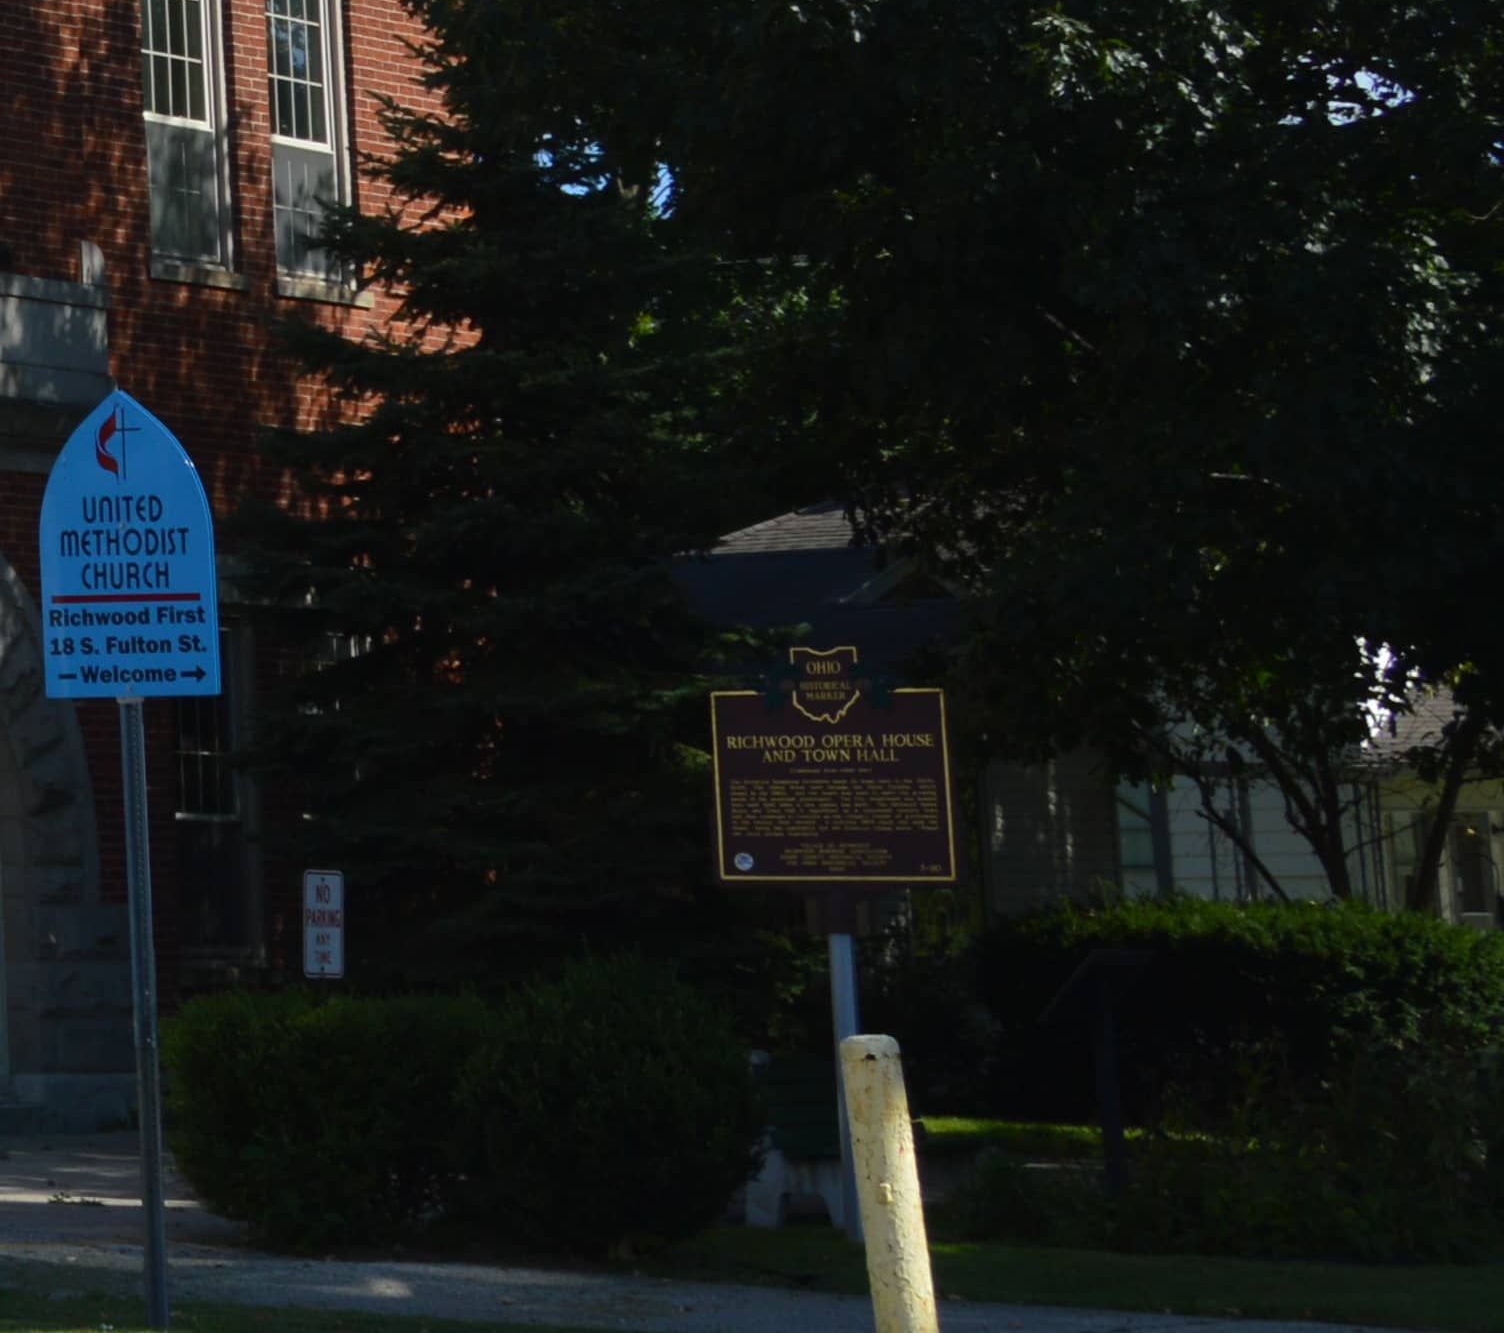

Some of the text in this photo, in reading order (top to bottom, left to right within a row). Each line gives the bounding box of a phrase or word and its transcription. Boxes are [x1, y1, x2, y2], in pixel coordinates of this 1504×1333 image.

[82, 495, 163, 523] UNITED
[60, 528, 189, 558] METHODIST
[81, 562, 170, 589] CHURCH
[49, 605, 206, 627] Richwood First
[50, 635, 207, 656] 18 S. Fulton St.
[80, 664, 177, 684] Welcome
[806, 660, 841, 675] OHIO
[726, 733, 935, 750] RICHWOOD OPERA HOUSE
[762, 748, 900, 763] AND TOWN HALL
[305, 909, 343, 928] PARKING
